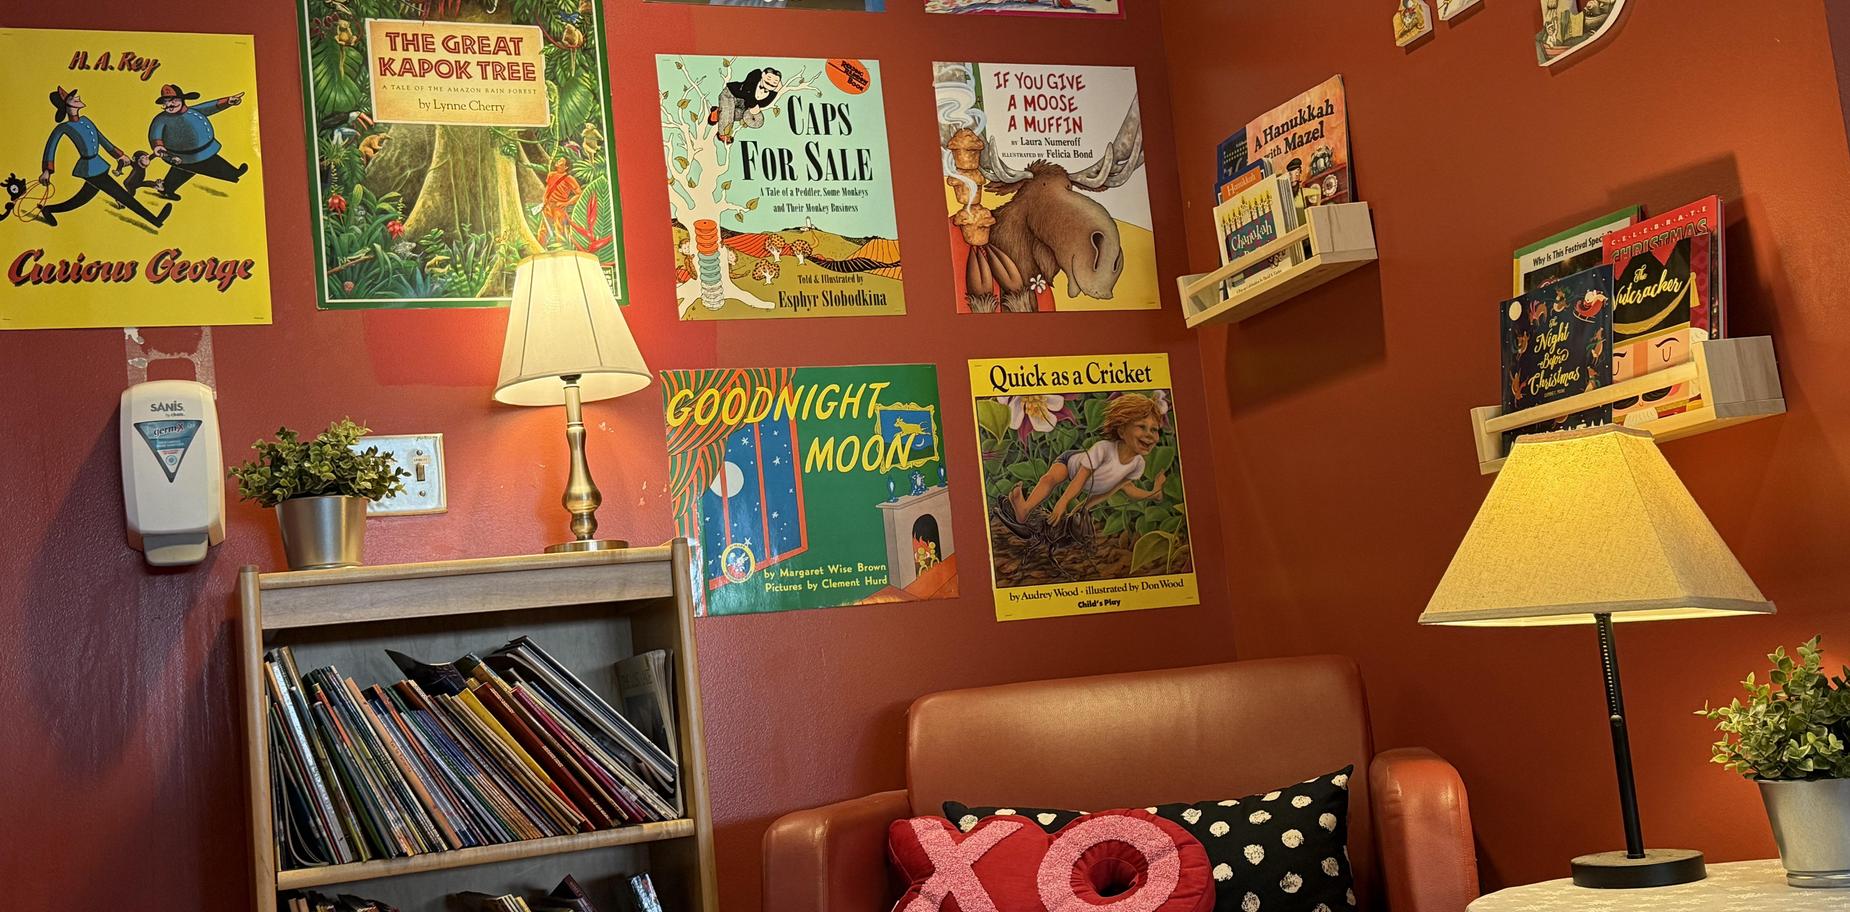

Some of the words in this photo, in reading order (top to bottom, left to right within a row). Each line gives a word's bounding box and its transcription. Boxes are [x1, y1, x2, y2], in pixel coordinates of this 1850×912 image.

[386, 32, 436, 53] THE
[441, 34, 523, 56] GREAT
[69, 51, 88, 71] H.
[94, 52, 113, 71] A.
[118, 52, 160, 81] Rey
[378, 57, 473, 80] KAPOK
[477, 61, 537, 81] TREE
[993, 71, 1011, 90] IF
[1014, 72, 1044, 90] YOU
[1047, 73, 1086, 92] GIVE
[418, 98, 431, 111] by
[433, 98, 467, 112] Lynne
[468, 100, 506, 114] Cherry
[787, 95, 852, 136] CAPS
[1007, 94, 1017, 112] A
[1023, 94, 1078, 113] MOOSE
[1007, 115, 1017, 132] A
[1023, 115, 1083, 134] MUFFIN
[1254, 135, 1263, 153] A
[1262, 98, 1335, 146] Hanukkah
[1020, 137, 1043, 146] Laura
[1044, 137, 1082, 147] Numeroff
[1283, 120, 1325, 155] Mazel
[739, 140, 799, 182] FOR
[804, 140, 873, 182] SALE
[1046, 149, 1071, 159] Felicia
[1073, 149, 1094, 159] Bond
[760, 187, 764, 196] A
[766, 187, 781, 197] Tale
[782, 187, 789, 197] of
[795, 187, 822, 198] Peddler,
[823, 187, 840, 197] Some
[842, 188, 869, 199] Monkeys
[773, 204, 784, 213] and
[786, 203, 804, 213] Their
[805, 203, 830, 215] Monkey
[831, 203, 859, 213] Business
[1231, 220, 1273, 251] Chanukah
[1612, 218, 1708, 262] CHRISTMAS
[1532, 256, 1546, 268] Why
[1546, 252, 1552, 261] Is
[1552, 248, 1564, 259] This
[1564, 239, 1587, 256] Festival
[8, 248, 138, 286] Curious
[145, 248, 255, 292] George
[797, 275, 812, 284] Told
[813, 275, 819, 284] &
[821, 274, 855, 284] Illustrated
[856, 274, 864, 285] by
[1633, 264, 1648, 283] The
[778, 290, 818, 312] Esphyr
[822, 289, 887, 308] Slobodkina
[1534, 322, 1570, 355] Night
[1537, 348, 1569, 370] Before
[989, 363, 1049, 393] Quick
[1051, 370, 1070, 387] as
[1072, 370, 1083, 385] a
[1085, 360, 1153, 385] Cricket
[1528, 366, 1580, 396] Christmas
[666, 381, 891, 427] GOODNIGHT
[805, 433, 916, 474] MOON
[763, 569, 775, 580] by
[780, 566, 824, 578] Margaret
[827, 564, 853, 574] Wise
[857, 562, 887, 572] Brown
[765, 582, 803, 593] Pictures
[807, 580, 818, 591] by
[821, 578, 860, 589] Clement
[865, 575, 888, 586] Hurd
[1009, 592, 1020, 603] by
[1021, 590, 1053, 601] Audrey
[1054, 587, 1079, 598] Wood
[1085, 585, 1128, 595] illustrated
[1128, 582, 1140, 593] by
[1141, 582, 1160, 591] Don
[1160, 578, 1185, 588] Wood
[1078, 599, 1103, 609] Child's
[1104, 598, 1121, 608] Play
[902, 815, 1181, 912] XO
